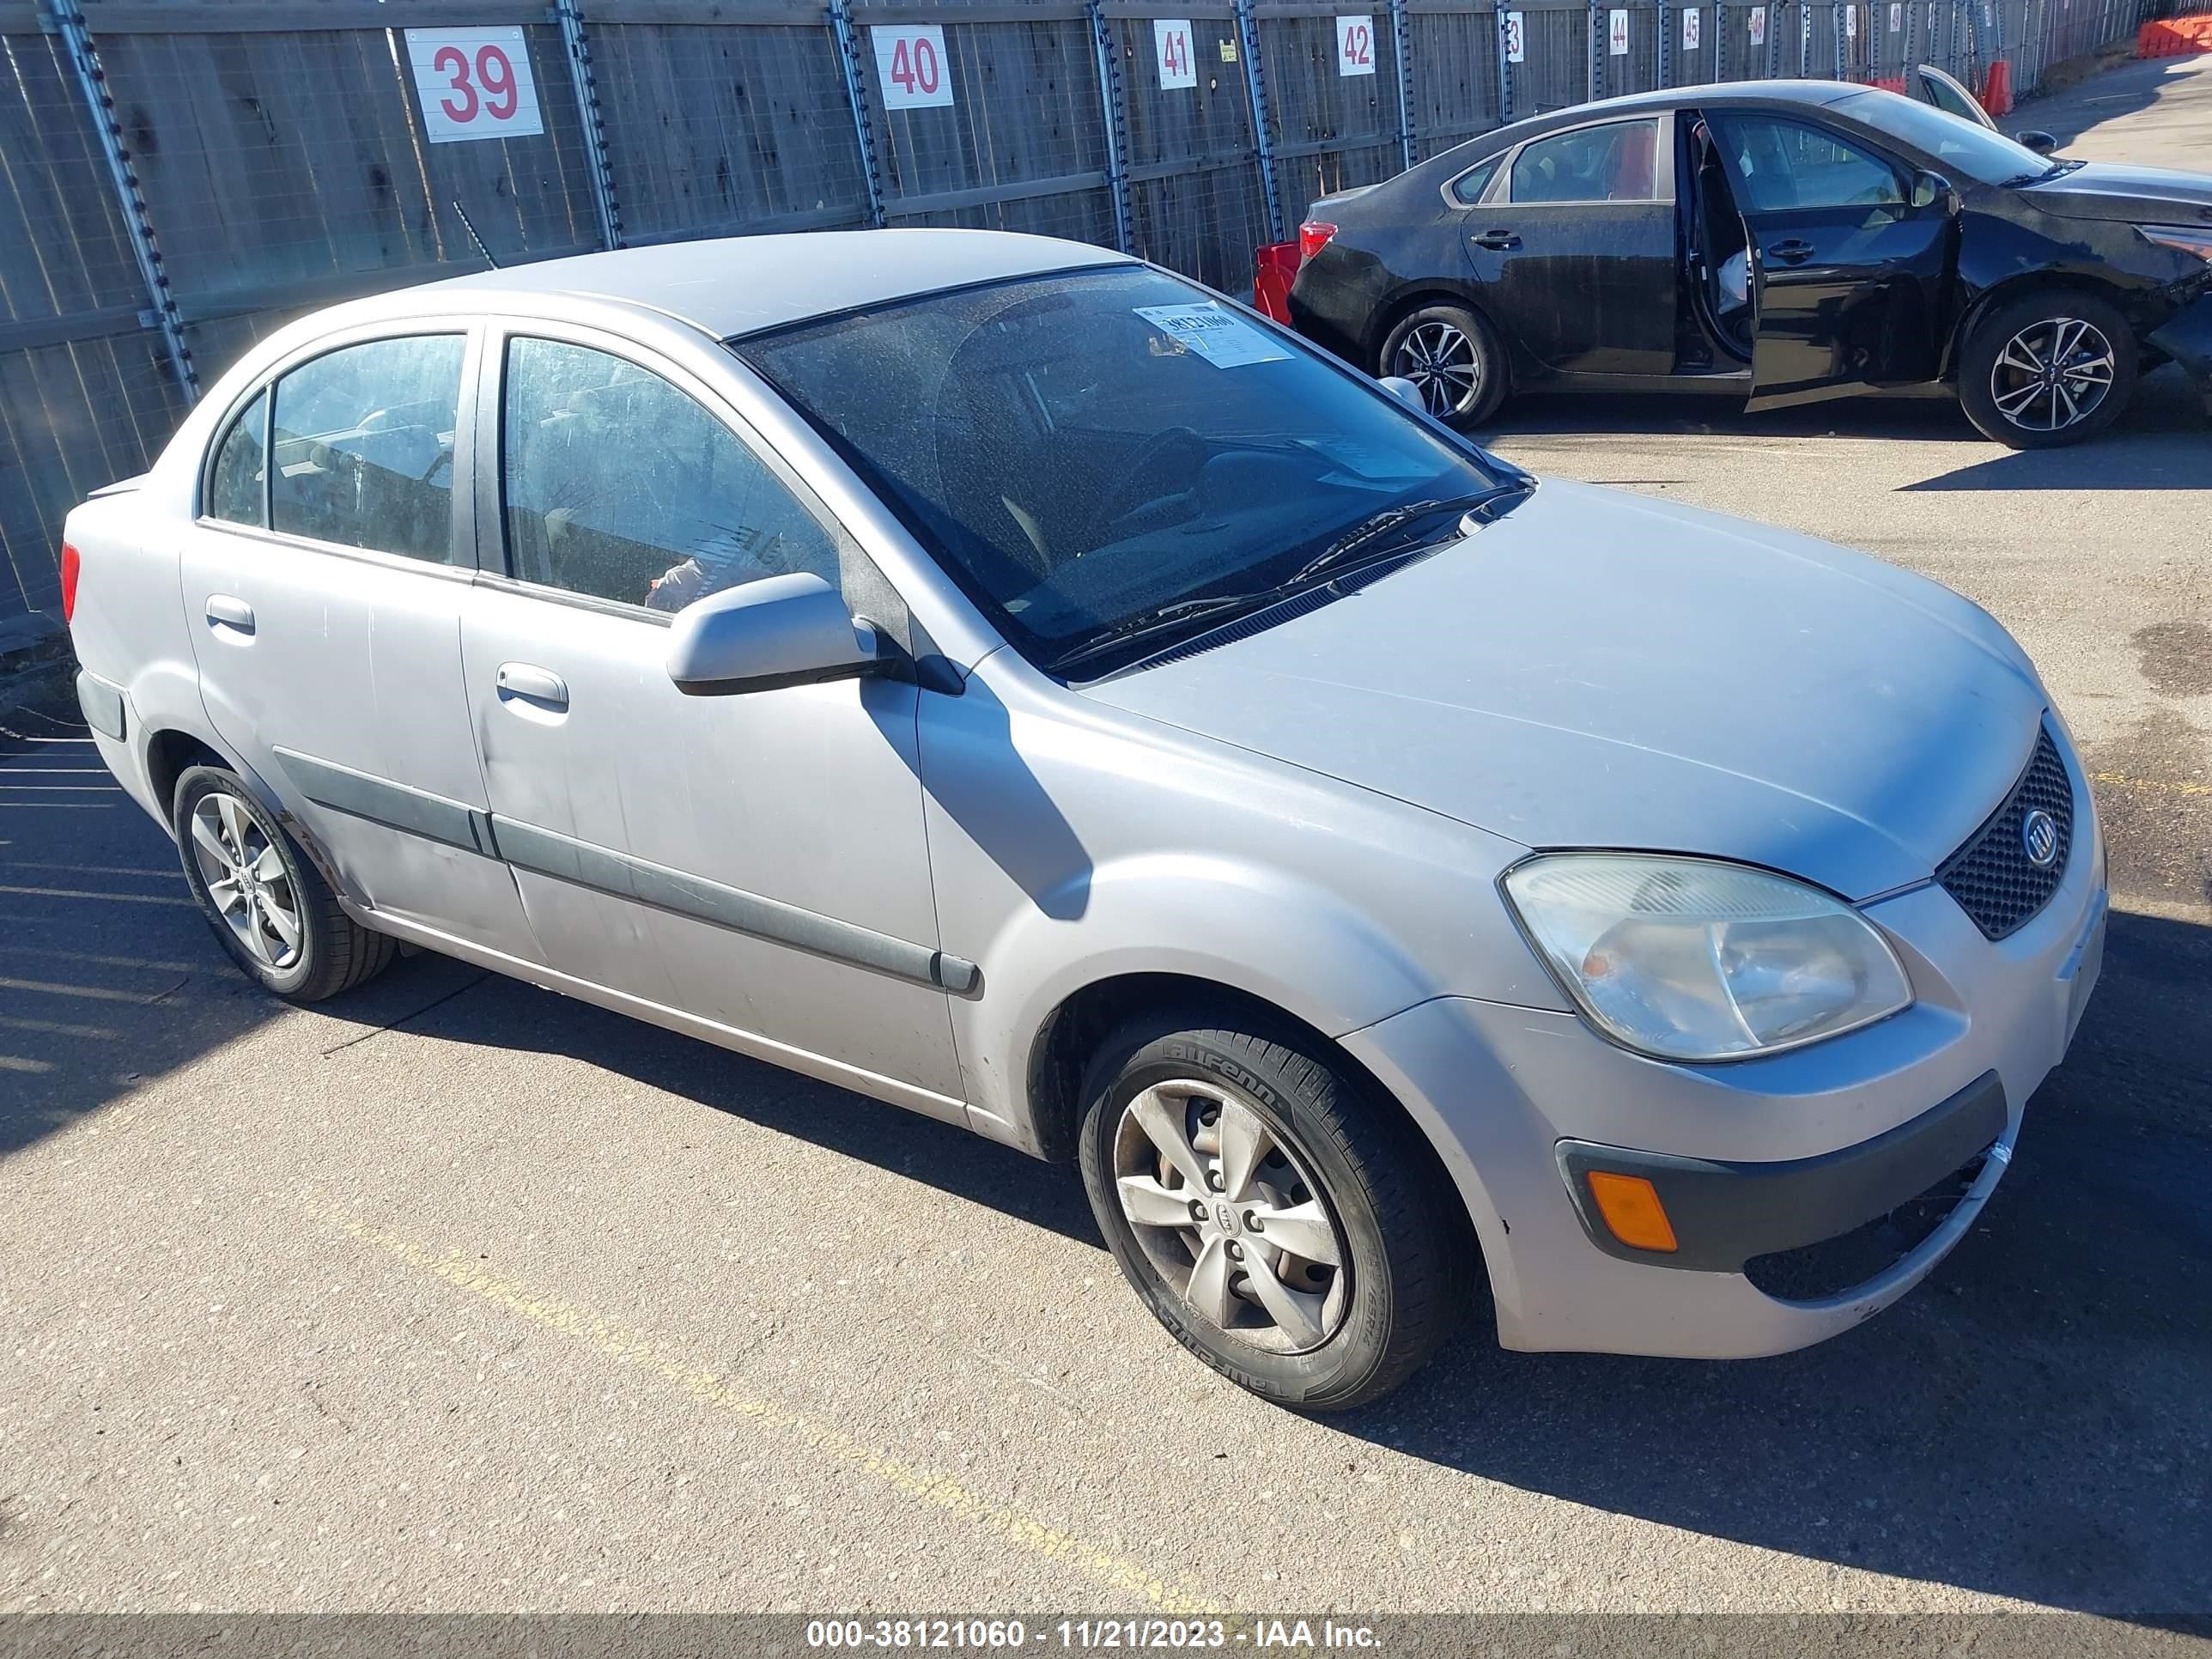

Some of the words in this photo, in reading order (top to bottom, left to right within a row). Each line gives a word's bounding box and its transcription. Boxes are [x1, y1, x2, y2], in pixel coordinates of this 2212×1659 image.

[1344, 25, 1370, 65] 42
[1510, 20, 1520, 55] 3
[1613, 16, 1626, 48] 44
[1686, 15, 1698, 43] 45
[890, 37, 941, 96] 40
[1164, 30, 1188, 77] 41
[432, 44, 519, 124] 39
[1164, 314, 1235, 331] 38121060
[2028, 818, 2055, 859] KIA
